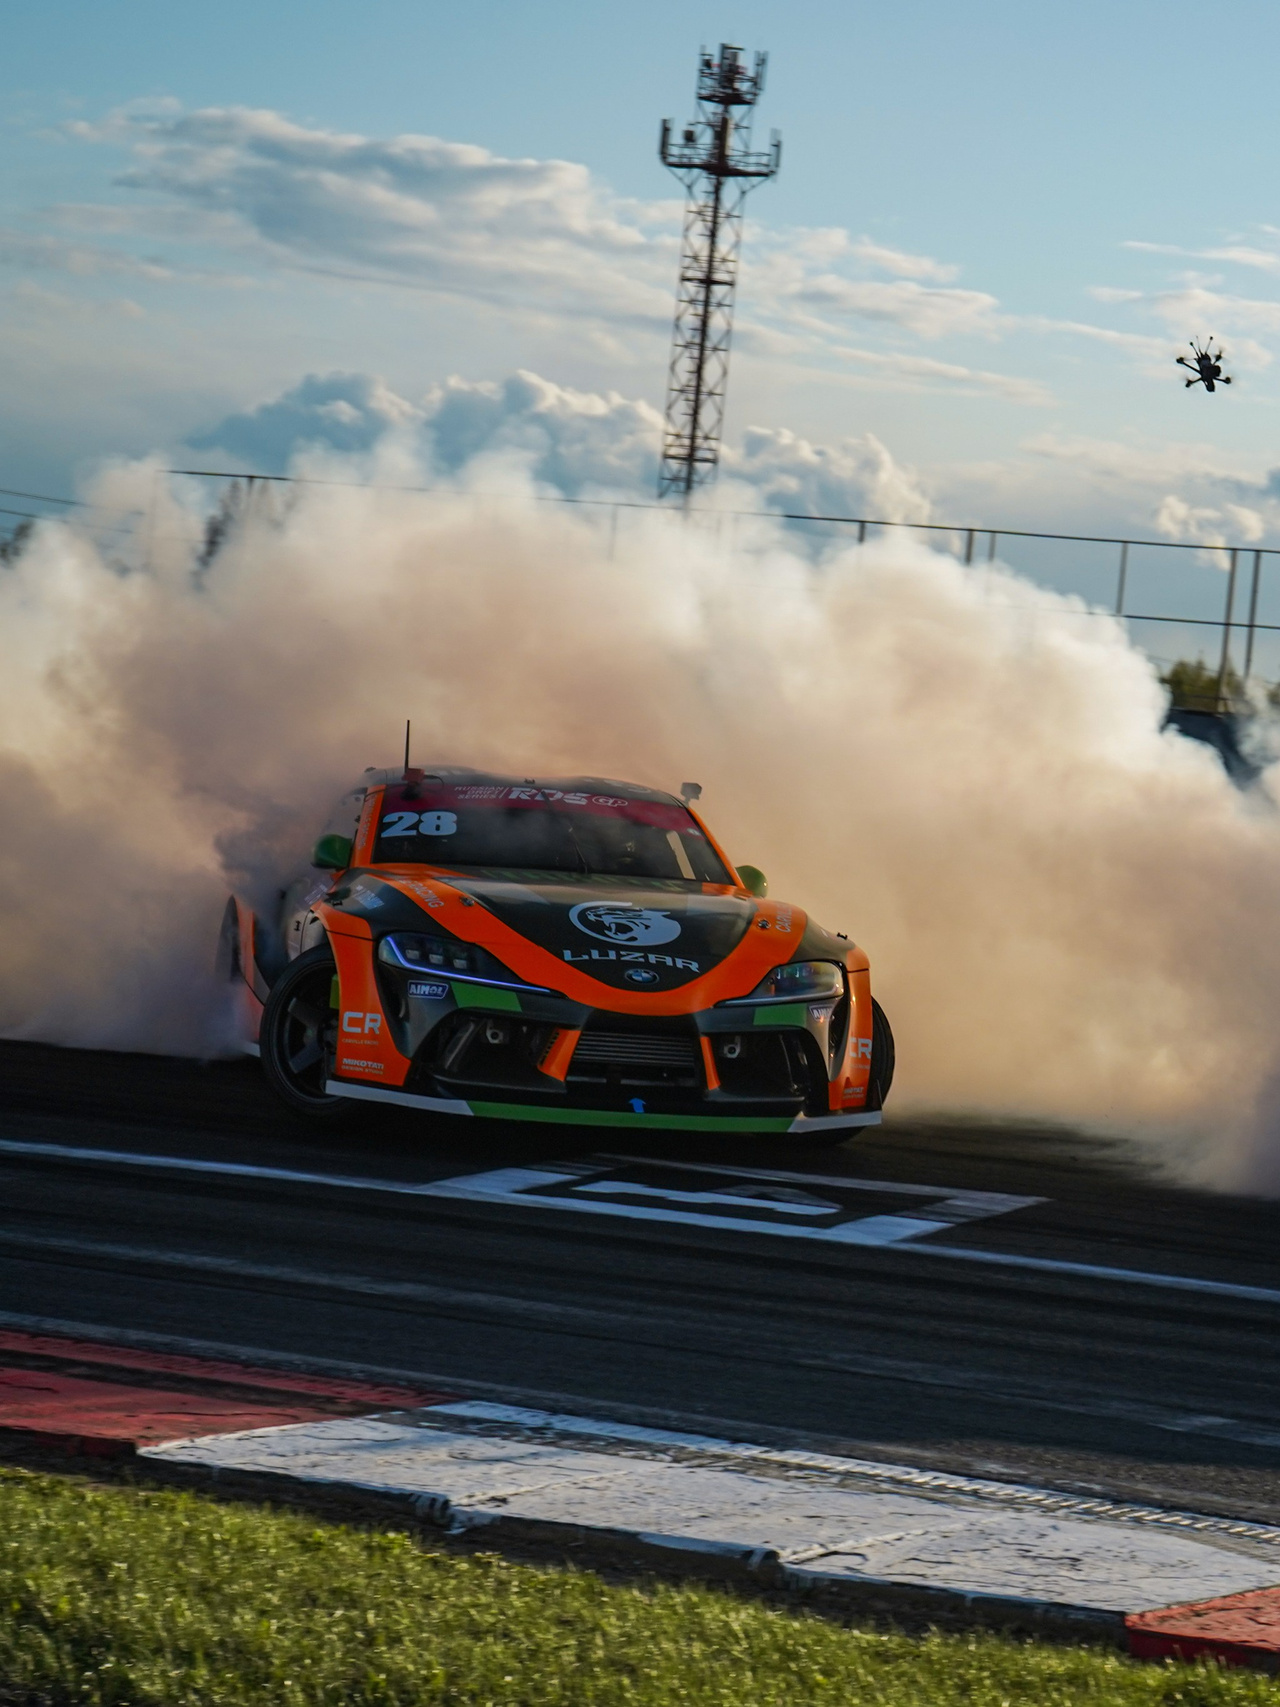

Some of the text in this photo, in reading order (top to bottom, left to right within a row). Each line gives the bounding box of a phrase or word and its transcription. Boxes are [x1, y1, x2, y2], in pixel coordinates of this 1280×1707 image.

[454, 784, 504, 792] RUSSIAN
[466, 789, 500, 797] DRIFT
[508, 786, 591, 805] RDS
[380, 811, 458, 838] 28
[562, 948, 701, 973] LUZAR
[342, 1011, 381, 1034] CR
